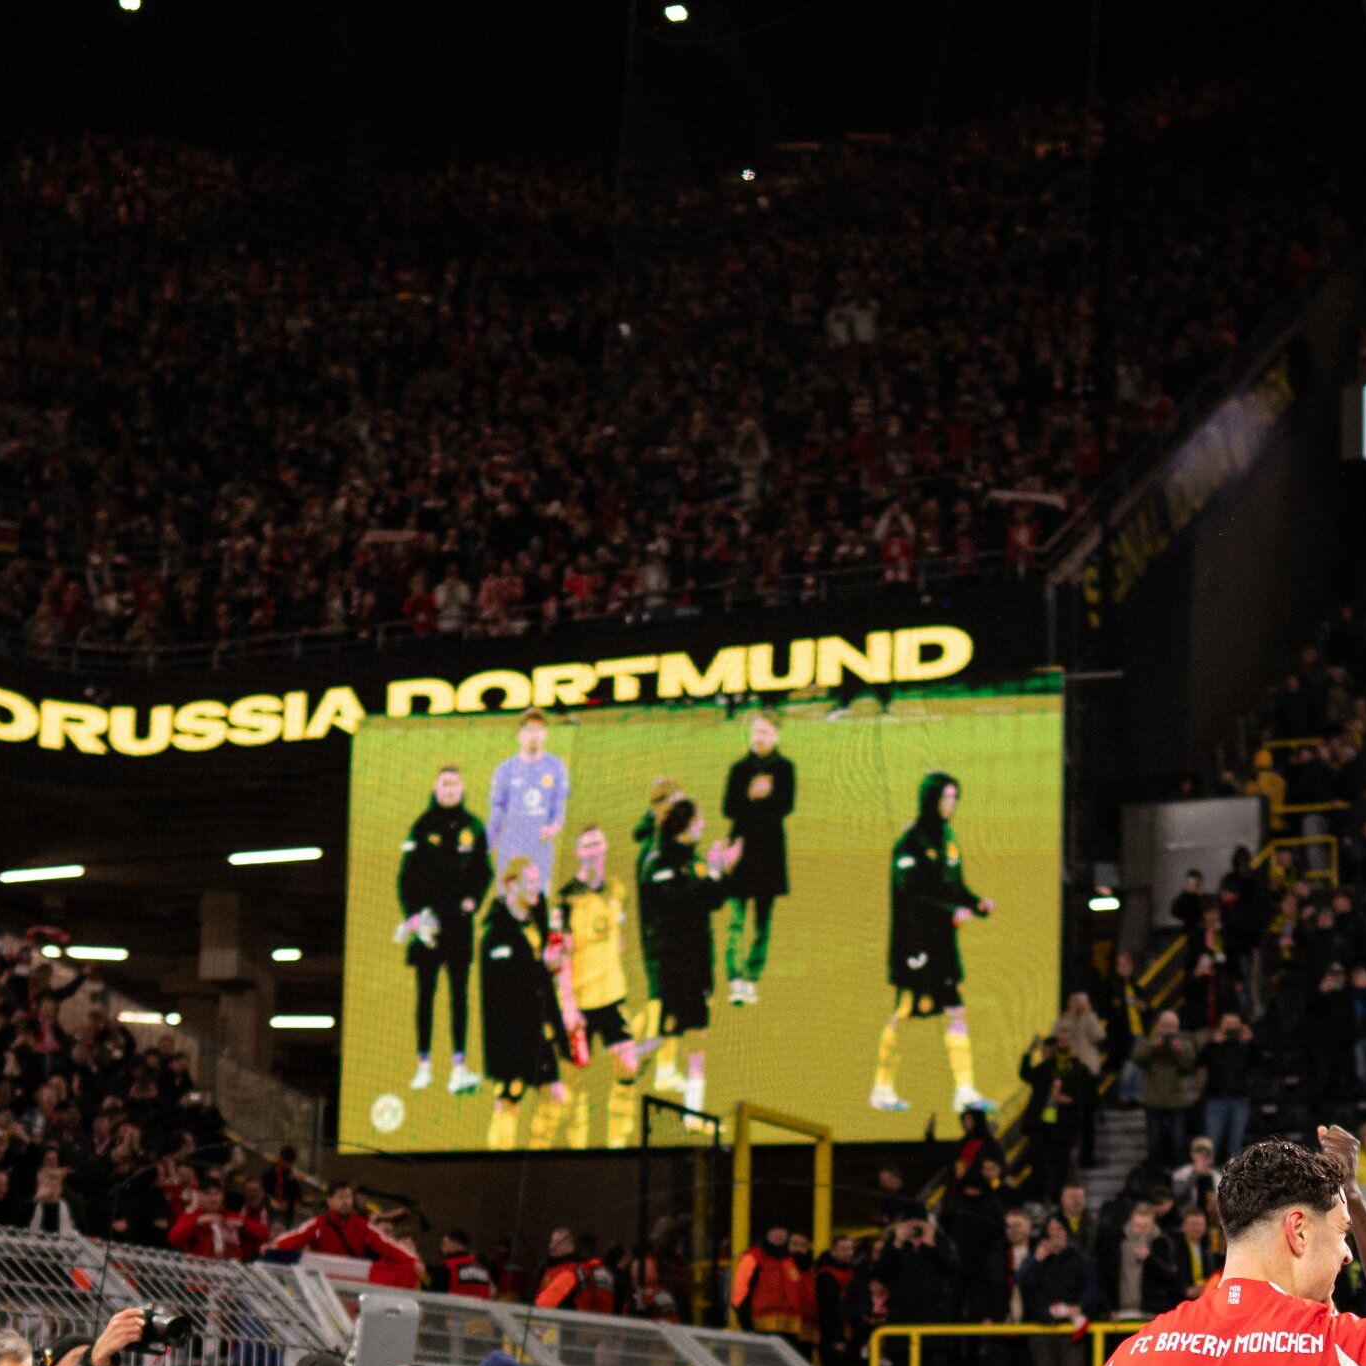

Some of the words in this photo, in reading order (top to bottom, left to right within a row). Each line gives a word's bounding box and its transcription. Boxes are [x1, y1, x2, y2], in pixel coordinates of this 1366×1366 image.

[386, 625, 974, 717] DORTMUND
[1130, 1334, 1153, 1356] FC
[1154, 1331, 1232, 1358] BAYERN
